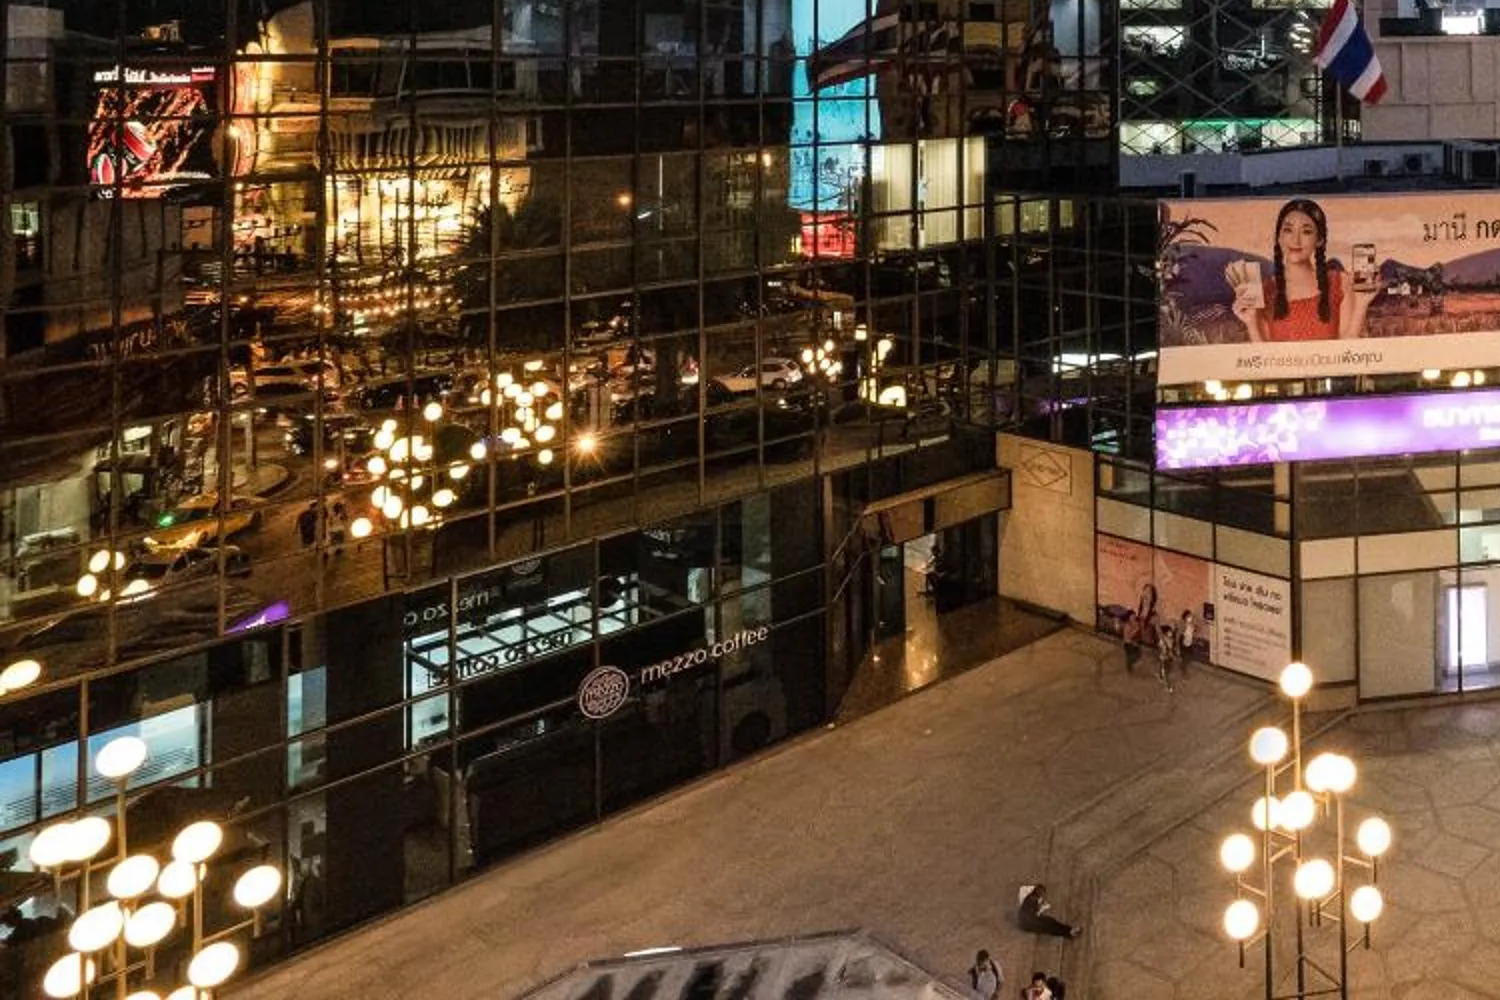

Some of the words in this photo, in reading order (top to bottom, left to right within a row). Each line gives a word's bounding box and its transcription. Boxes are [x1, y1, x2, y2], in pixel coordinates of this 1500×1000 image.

[1423, 212, 1467, 243] มานี
[641, 648, 707, 685] mezzo
[711, 625, 769, 657] coffee
